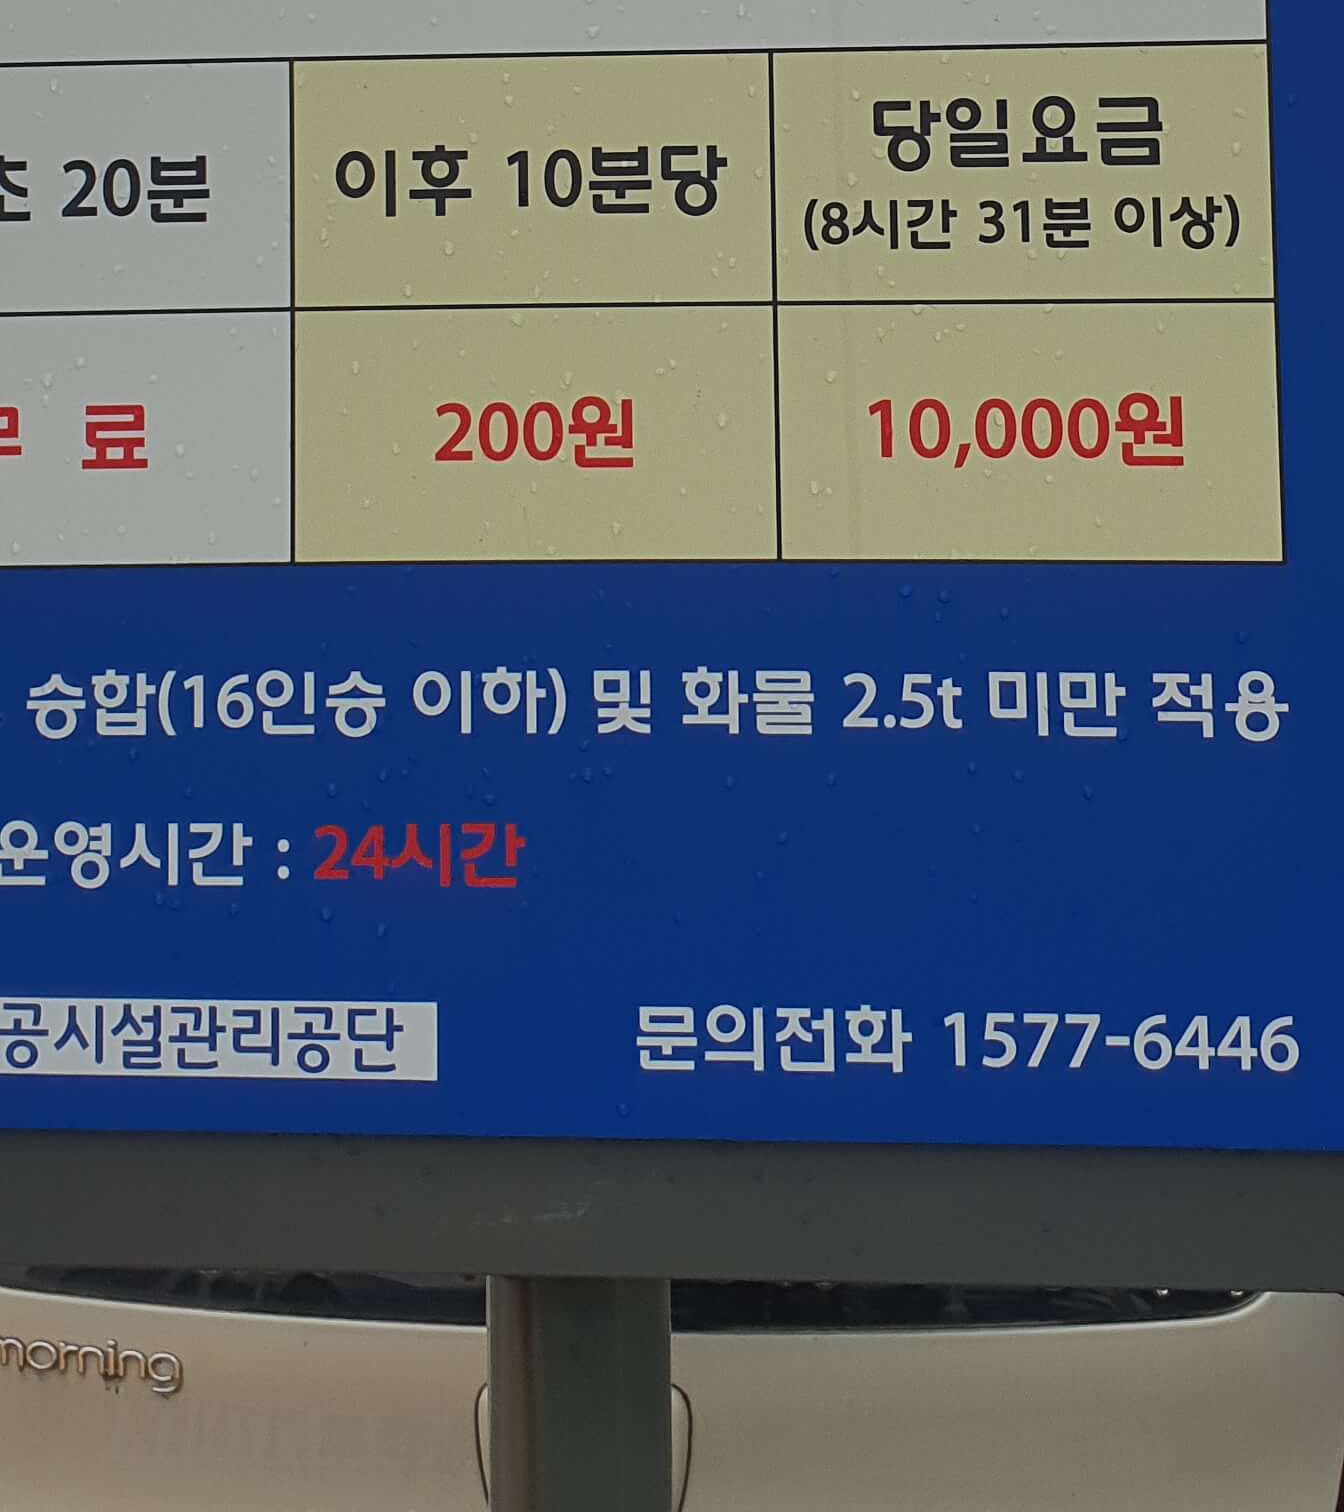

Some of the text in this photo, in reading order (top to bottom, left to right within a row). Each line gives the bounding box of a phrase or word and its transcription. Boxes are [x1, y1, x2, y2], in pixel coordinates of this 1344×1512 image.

[871, 95, 1165, 172] 당일요금
[60, 154, 211, 225] 20분
[334, 144, 729, 218] 이후 10분당
[802, 193, 1241, 252] (8시간 31분 이상)
[434, 394, 637, 469] 200원
[867, 390, 1186, 469] 10,000원
[26, 668, 387, 740] 승합(16인승
[412, 666, 567, 736] 이하)
[593, 669, 652, 735] 및
[681, 665, 816, 736] 화물
[842, 672, 964, 729] 2.5t
[988, 670, 1127, 738] 미만
[1151, 670, 1290, 742] 적용
[313, 822, 527, 888] 24시간
[636, 1004, 1301, 1074] 문의전화 1577-6446
